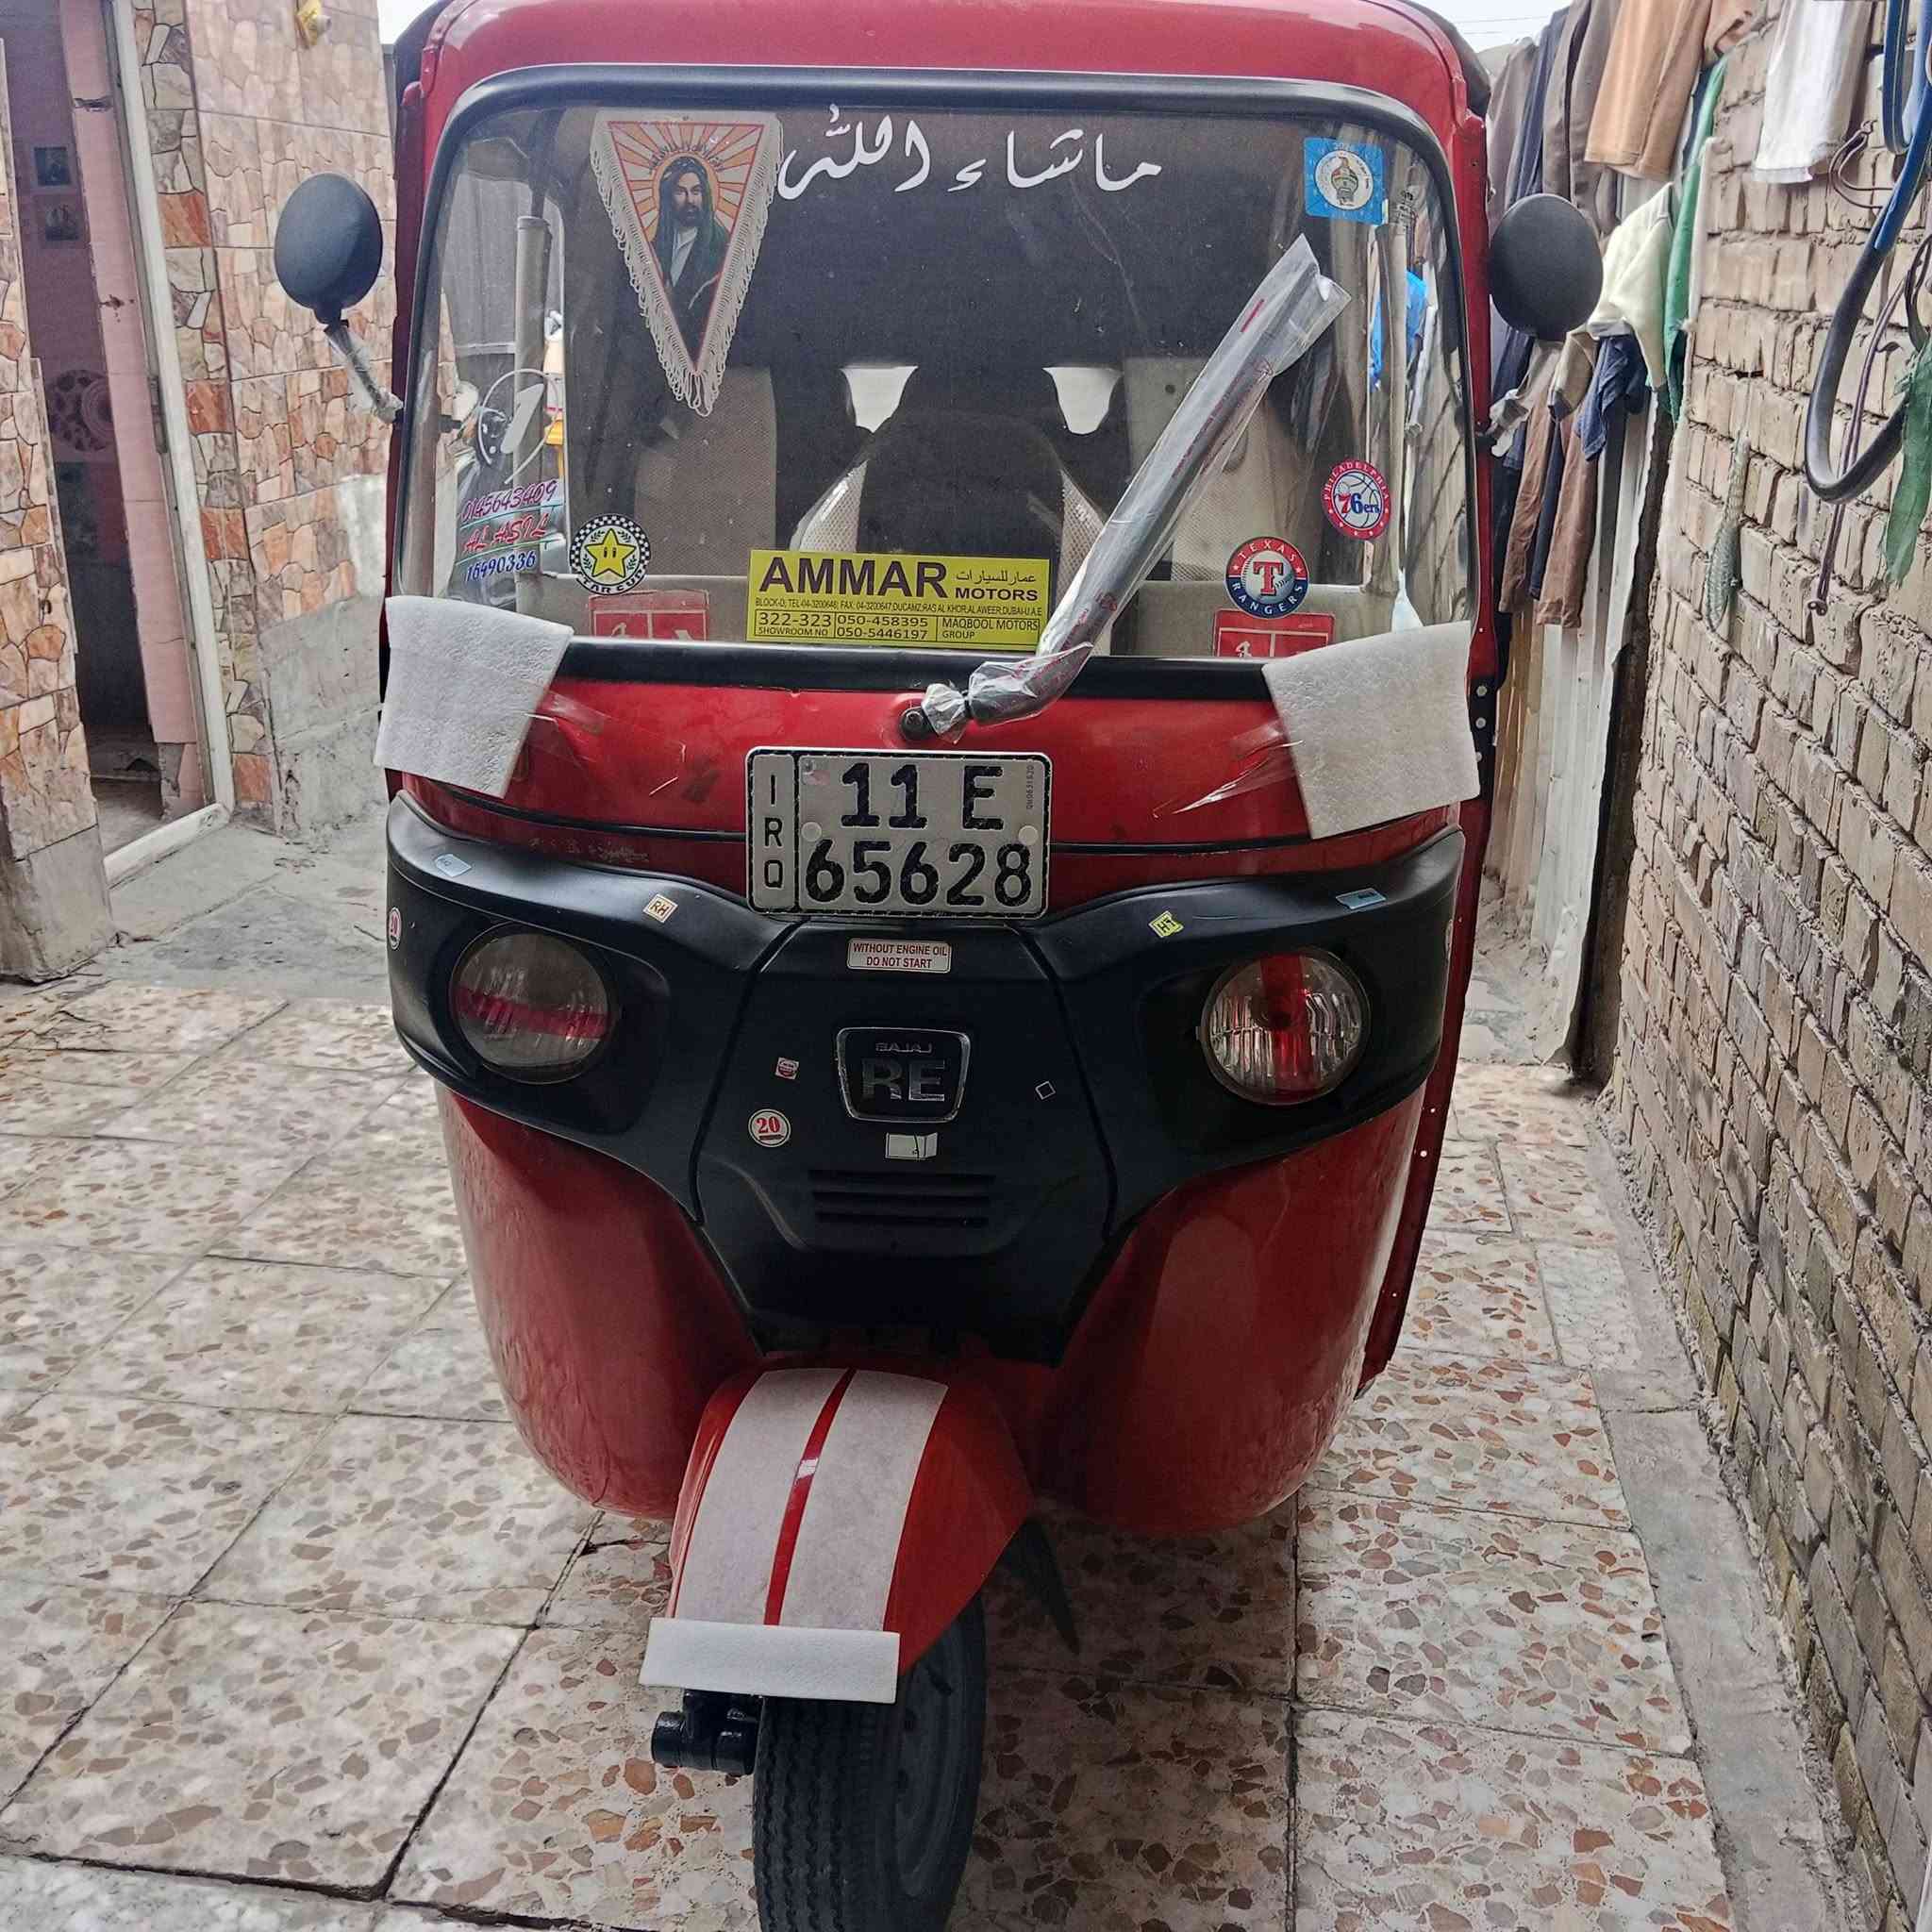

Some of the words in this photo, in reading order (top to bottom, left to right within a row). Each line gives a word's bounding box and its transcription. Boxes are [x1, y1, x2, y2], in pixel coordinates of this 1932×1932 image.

[1324, 461, 1390, 500] PHILADELPHIA
[1339, 492, 1380, 514] 76ers
[1237, 539, 1297, 562] TEXAS
[616, 569, 642, 591] CUP
[758, 557, 949, 599] AMMAR
[1252, 560, 1284, 597] T
[955, 587, 1039, 602] MOTORS
[1231, 582, 1304, 615] RANGERS
[758, 612, 832, 627] 322-323
[837, 614, 929, 627] 050-458395
[942, 617, 993, 630] MAQBOOL
[996, 620, 1039, 631] MOTORS
[758, 625, 813, 637] SHOWROOM
[837, 626, 929, 640] 050-5446197
[942, 630, 975, 639] GROUP
[841, 762, 928, 829] 11
[962, 765, 1004, 830] E
[805, 839, 1032, 908] 65628
[853, 942, 895, 954] WITHOUT
[896, 944, 930, 956] ENGINE
[932, 946, 947, 957] OIL
[866, 957, 880, 966] DO
[881, 957, 902, 967] NOT
[903, 958, 932, 969] START
[875, 1042, 933, 1054] BAJAJ
[861, 1058, 945, 1102] RE
[756, 1116, 781, 1133] 20
